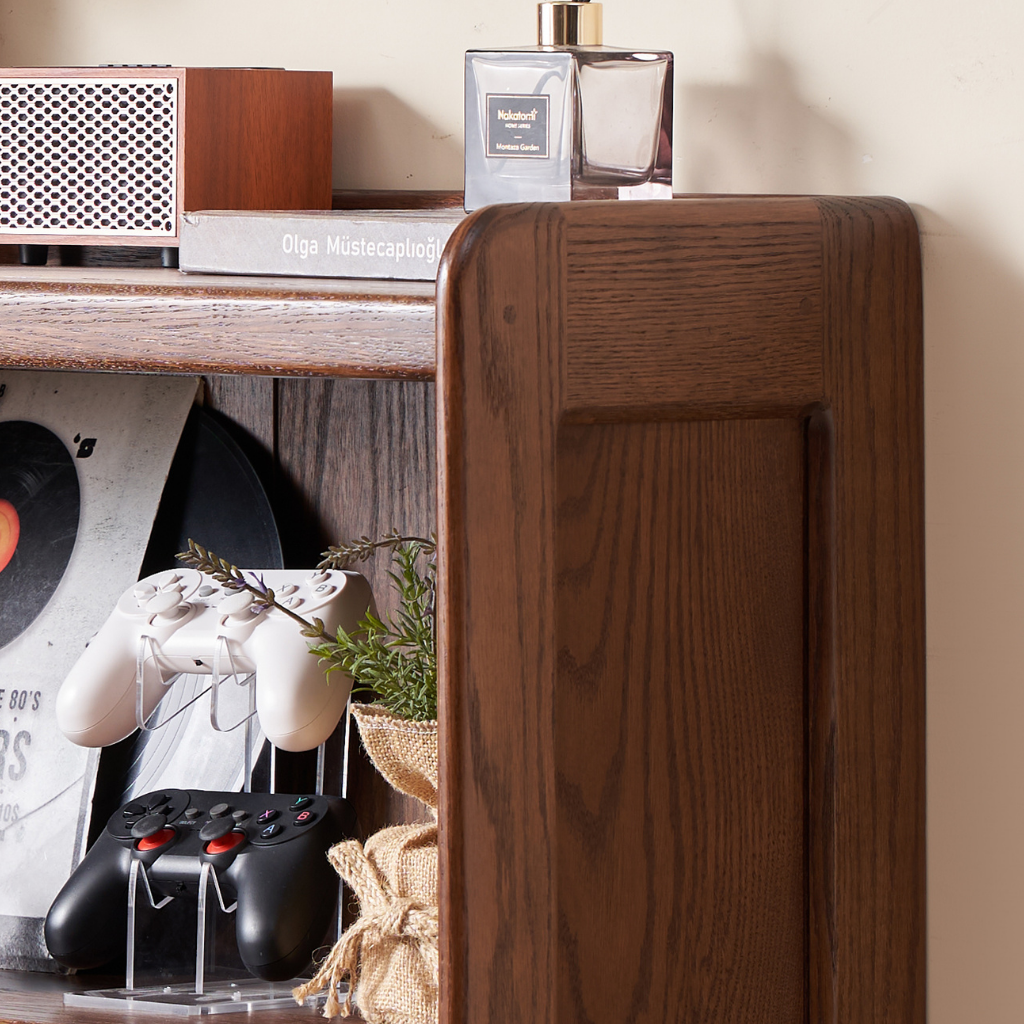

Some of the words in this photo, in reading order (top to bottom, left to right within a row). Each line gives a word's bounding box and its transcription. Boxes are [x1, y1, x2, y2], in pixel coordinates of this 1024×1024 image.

[282, 233, 319, 259] Olga
[326, 235, 445, 264] Müstecaplıoğl
[263, 825, 275, 834] A
[297, 811, 310, 820] B
